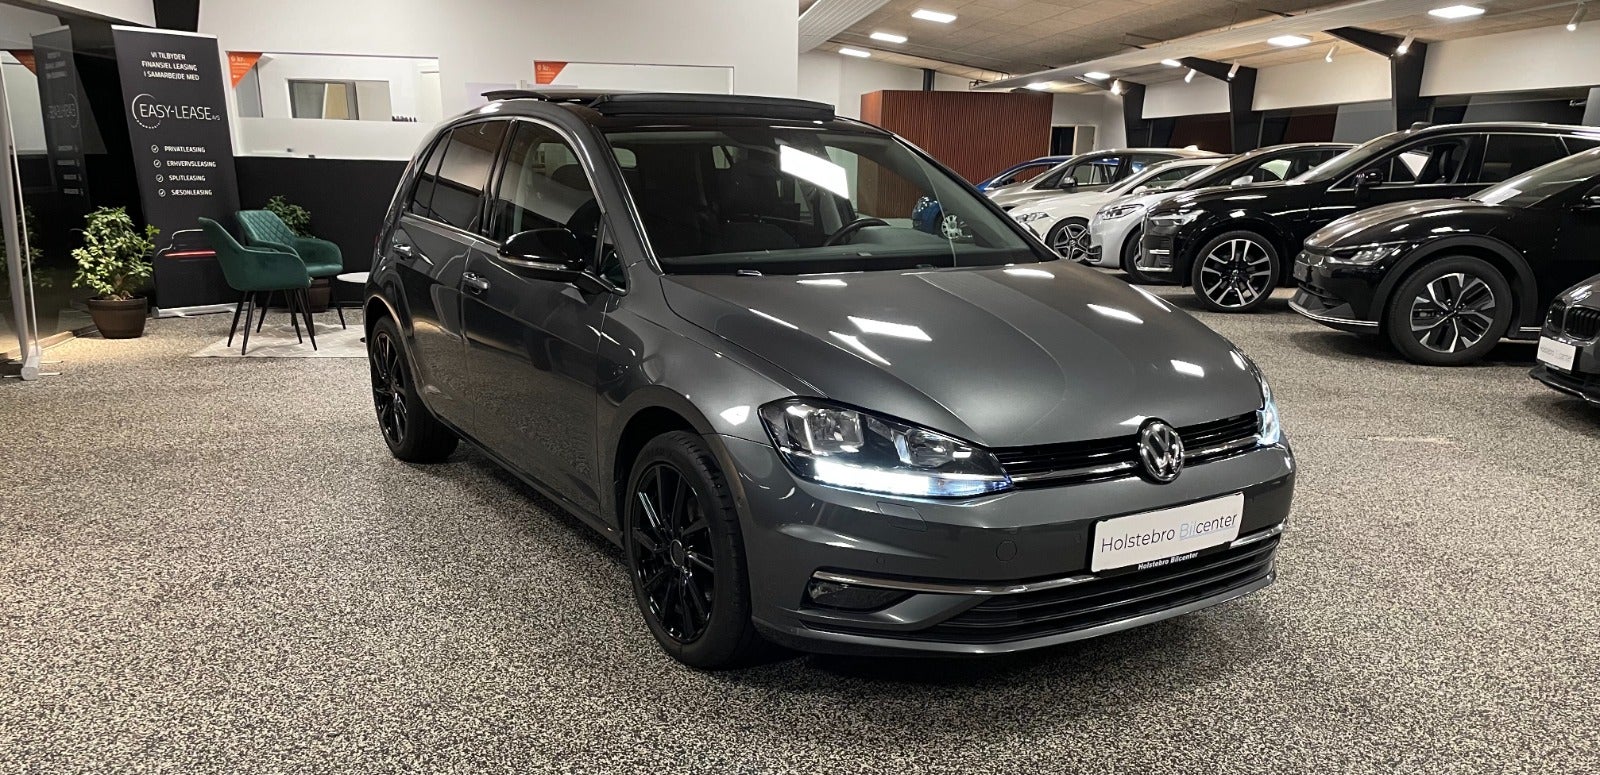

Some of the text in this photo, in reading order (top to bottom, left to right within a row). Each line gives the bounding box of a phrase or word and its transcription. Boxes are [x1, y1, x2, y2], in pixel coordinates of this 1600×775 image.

[158, 52, 186, 60] TILBYDER
[141, 60, 198, 71] FINANSIEL LEASING
[147, 71, 185, 80] SAMARBEJDE
[186, 73, 200, 81] MED
[139, 103, 212, 121] EASY-LEASE
[164, 145, 206, 153] PRIVATLEASING
[166, 160, 217, 168] ERHVERVSLEASING
[168, 174, 206, 182] SPLITLEASING
[170, 189, 213, 197] SÆSONLEASING
[1101, 513, 1238, 553] Holstebro Bilcenter
[1137, 551, 1199, 571] Holstebro Bilcenter
